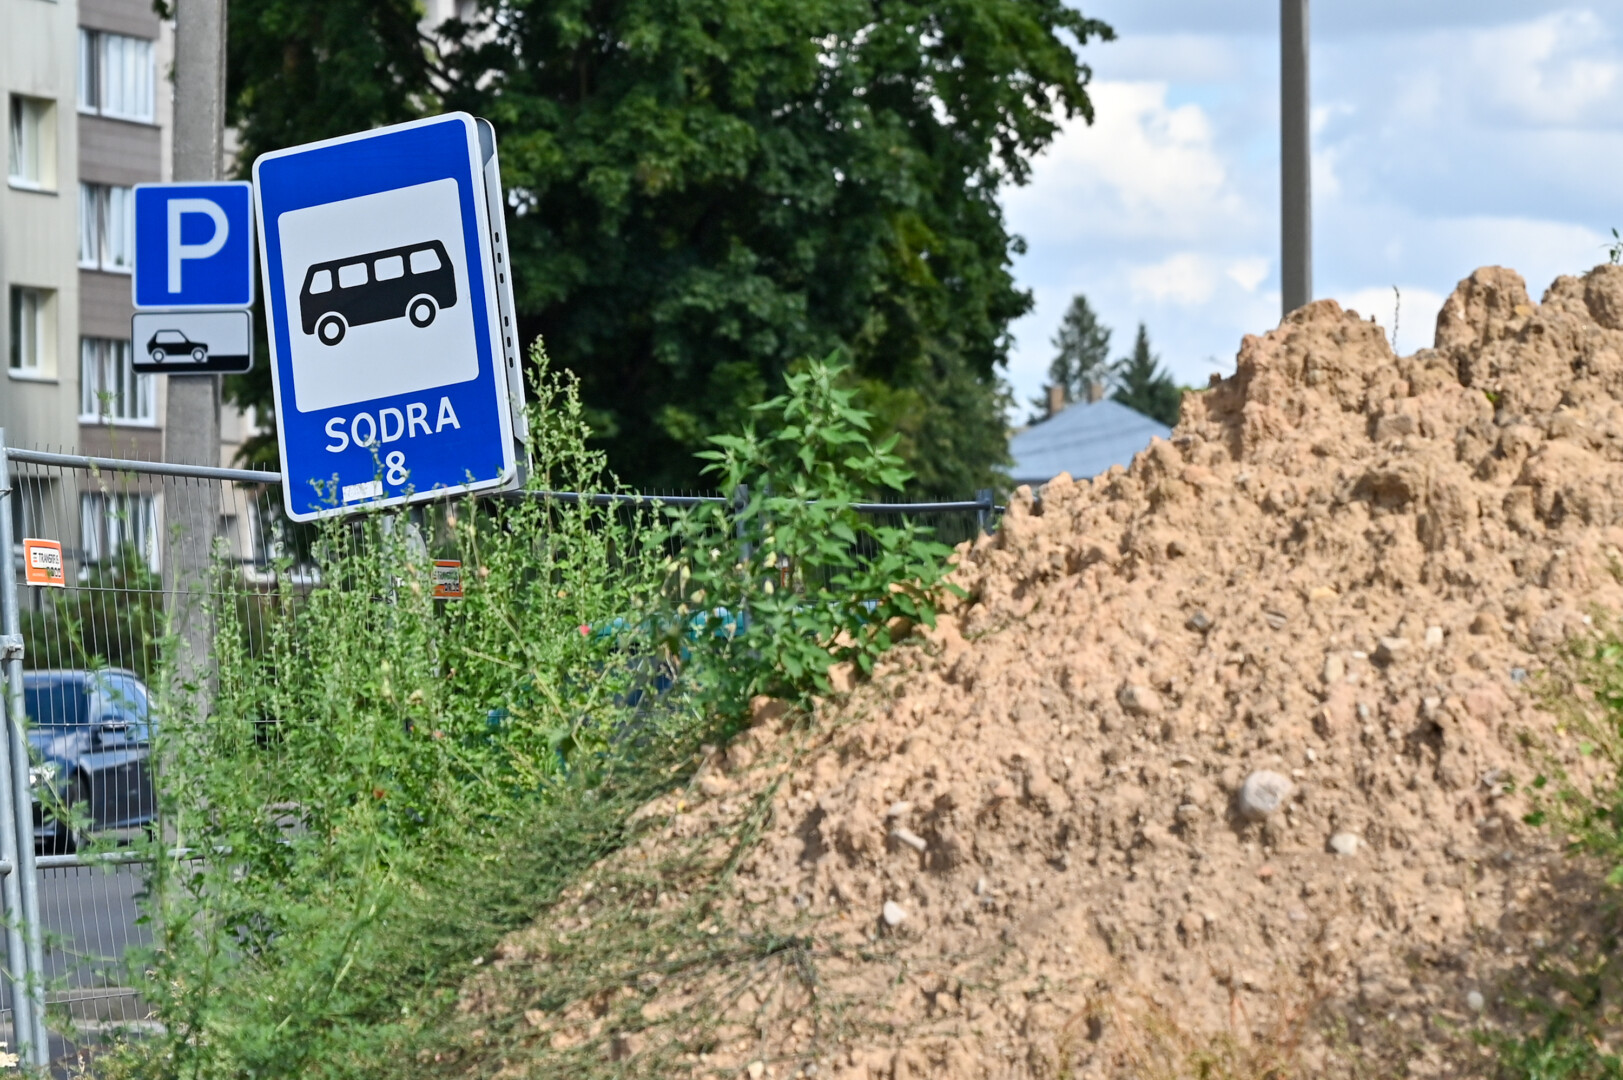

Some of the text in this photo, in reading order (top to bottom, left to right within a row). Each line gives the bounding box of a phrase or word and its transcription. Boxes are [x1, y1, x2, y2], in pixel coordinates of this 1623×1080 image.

[167, 198, 230, 294] P
[325, 396, 461, 453] SODRA
[385, 450, 408, 486] 8
